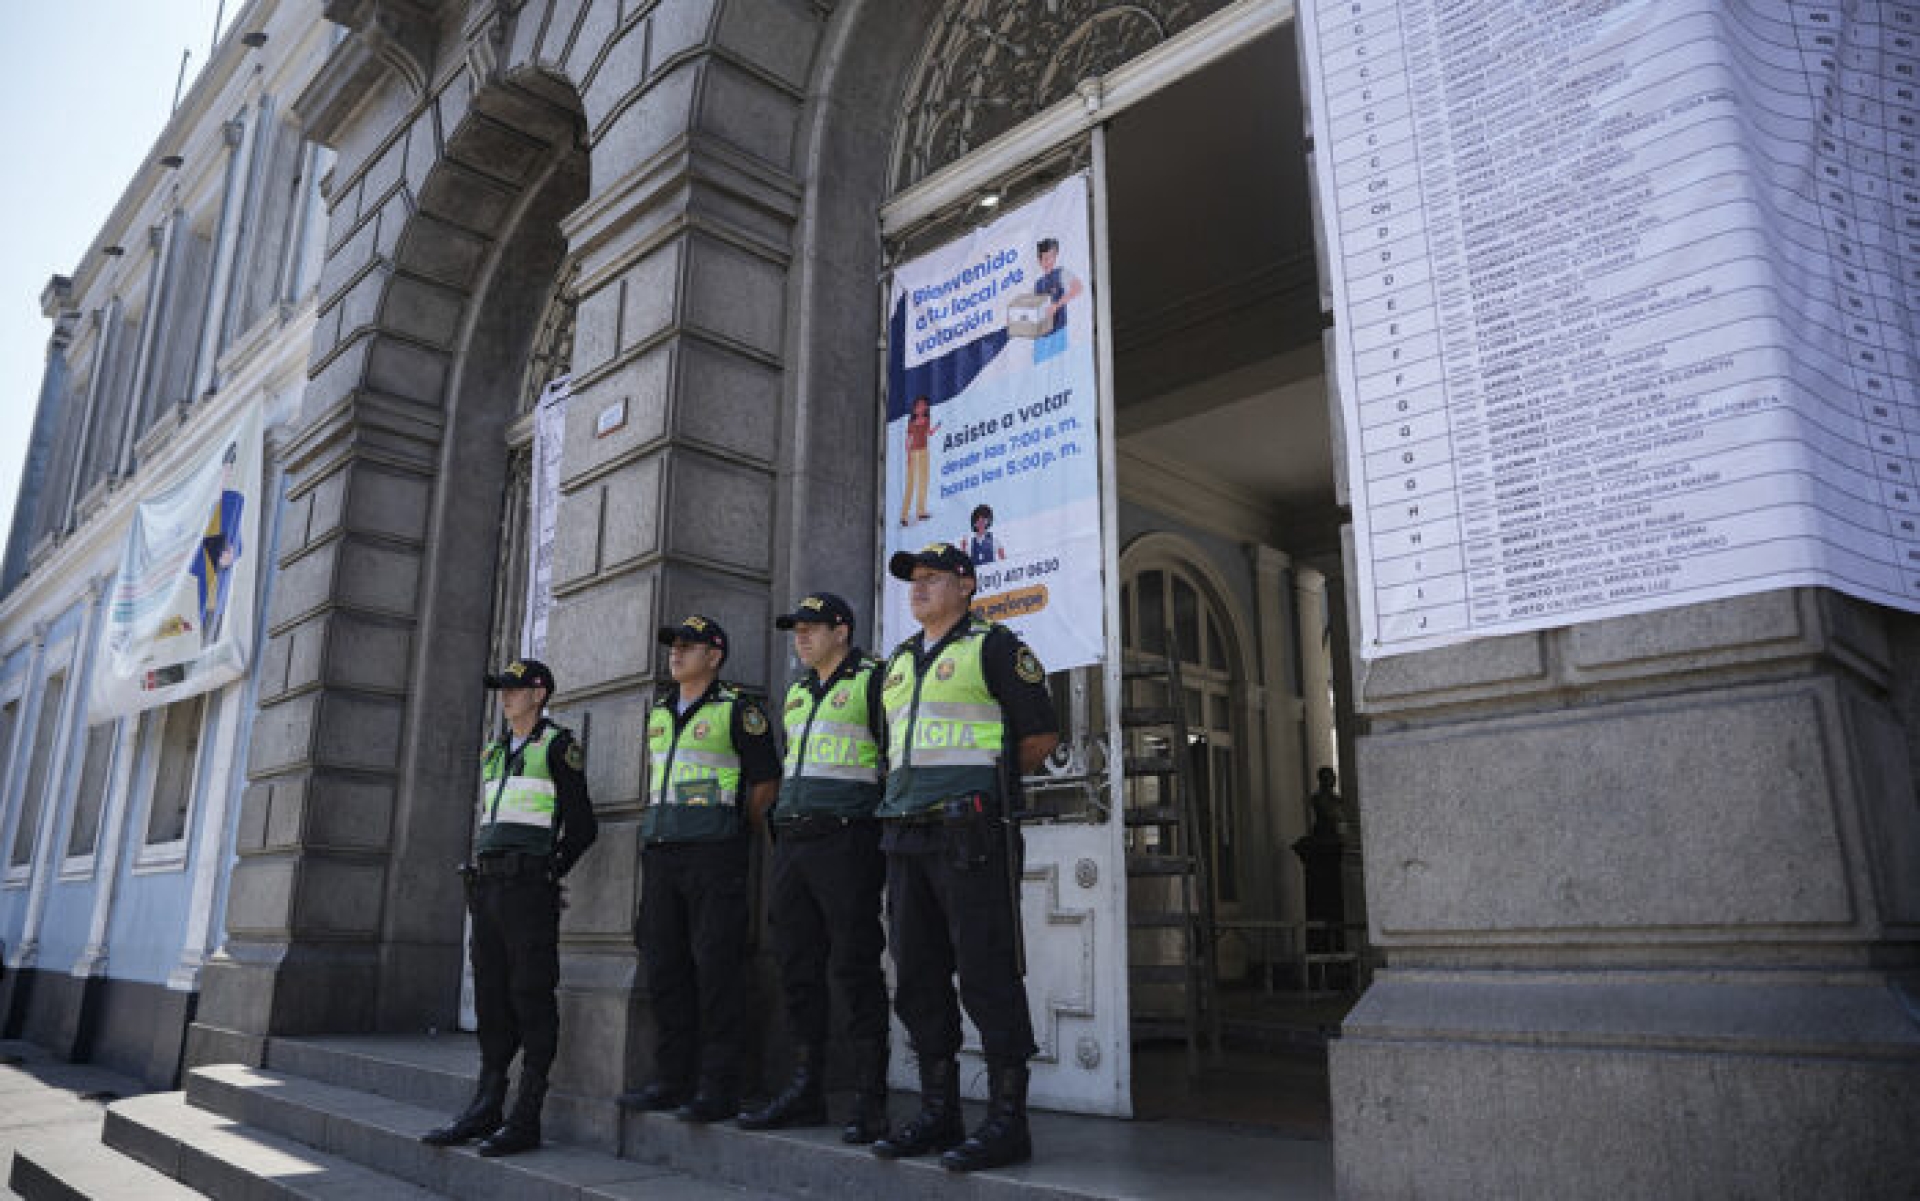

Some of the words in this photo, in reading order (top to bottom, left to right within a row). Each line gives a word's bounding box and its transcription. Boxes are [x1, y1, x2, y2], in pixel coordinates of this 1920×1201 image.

[913, 250, 1018, 307] Bienvenido
[915, 314, 928, 332] a
[927, 306, 948, 323] tu
[952, 279, 997, 315] local
[1001, 269, 1024, 292] de
[943, 424, 998, 452] Asiste
[1001, 412, 1013, 429] a
[1018, 388, 1072, 422] votar
[1009, 428, 1040, 450] 7:00
[1006, 452, 1039, 475] 5:00
